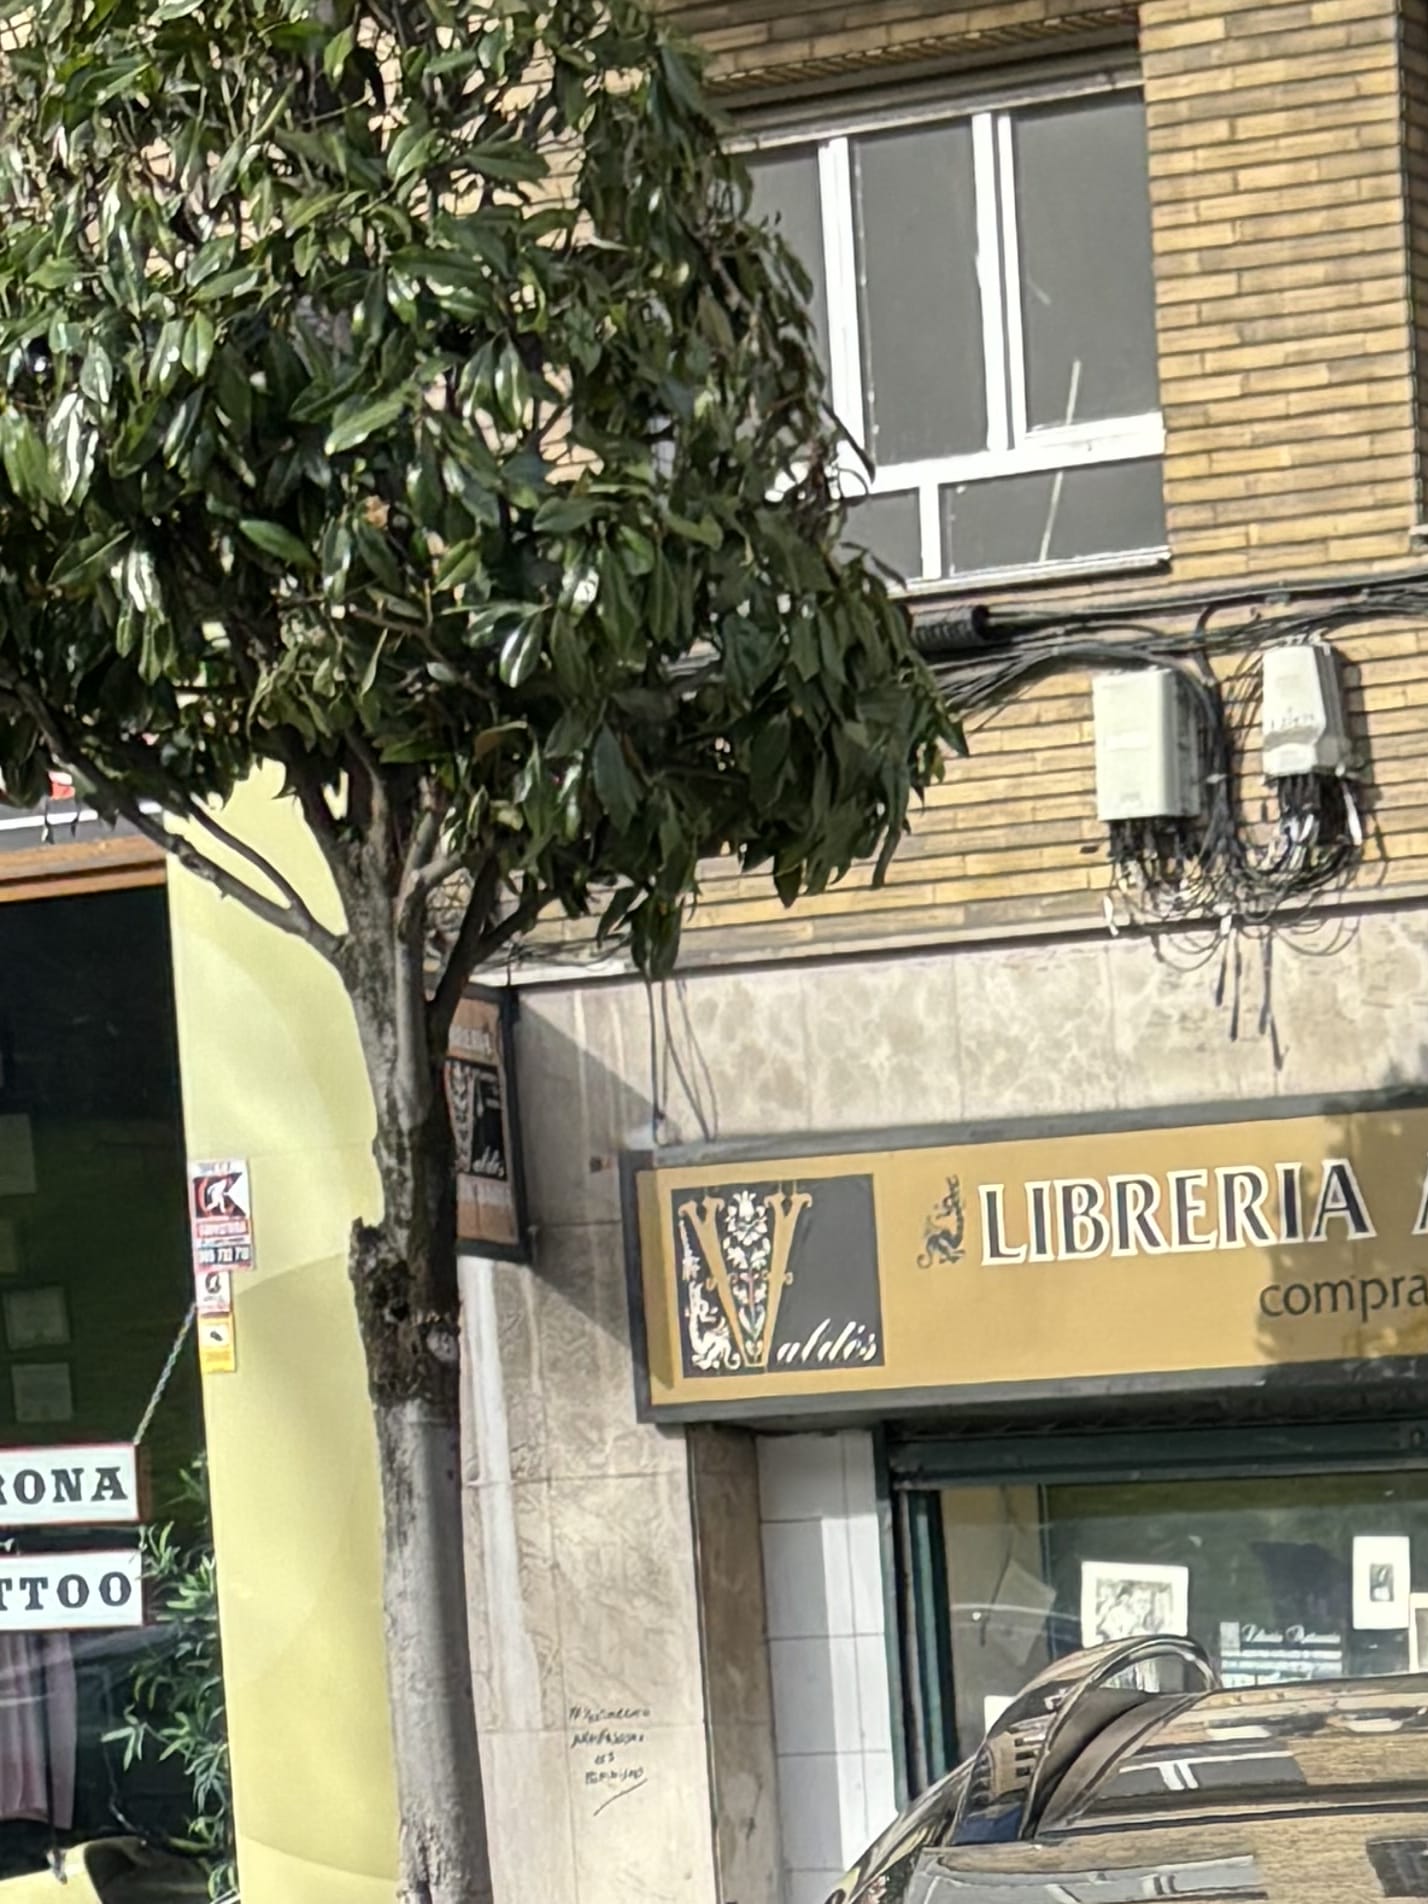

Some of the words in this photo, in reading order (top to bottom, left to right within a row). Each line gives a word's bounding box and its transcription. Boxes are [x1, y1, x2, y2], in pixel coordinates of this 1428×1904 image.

[978, 1158, 1377, 1266] LIBRERIA
[678, 1192, 877, 1367] Valdés
[0, 1467, 128, 1506] ONA
